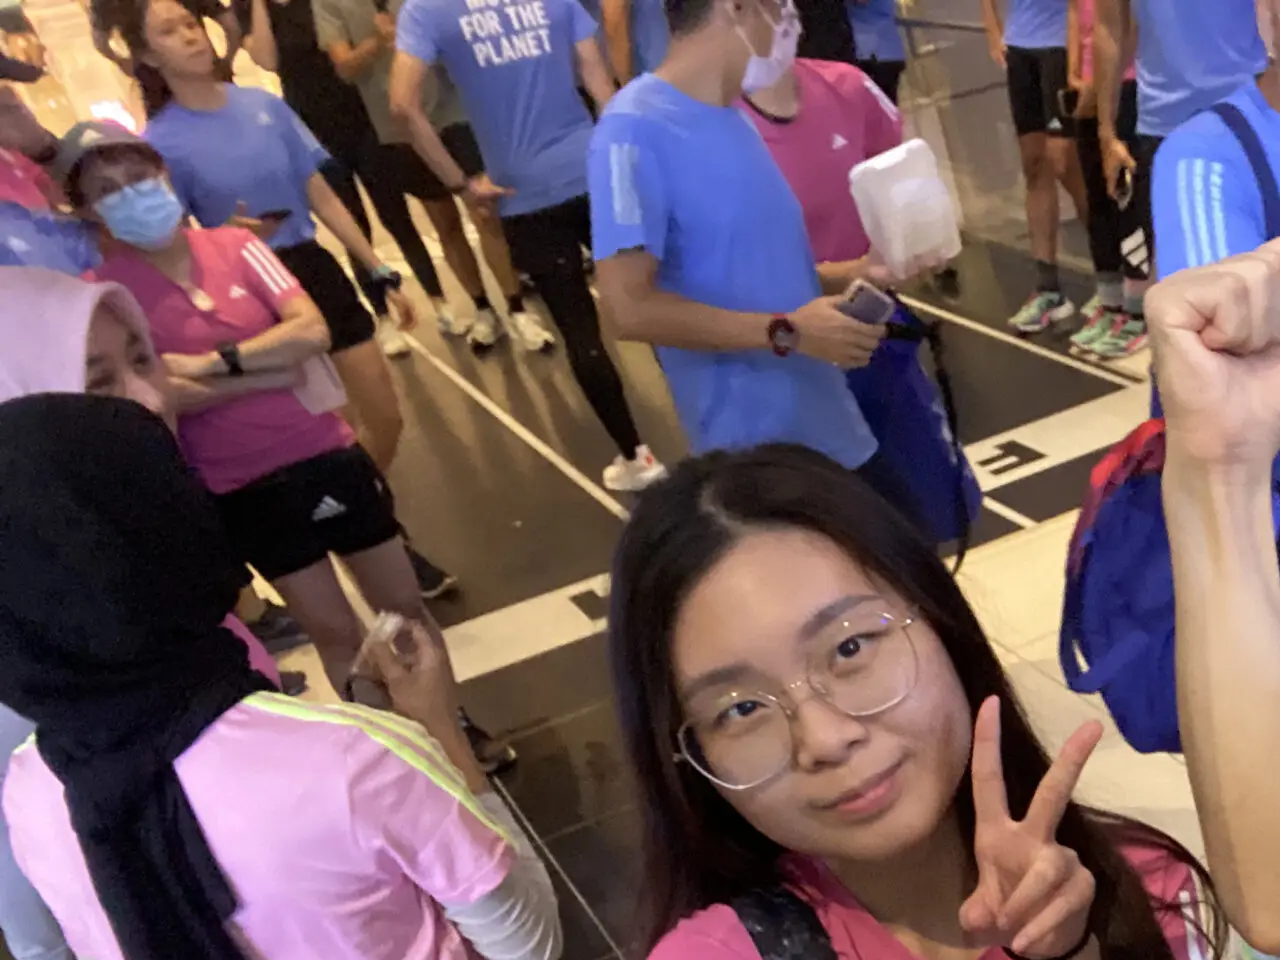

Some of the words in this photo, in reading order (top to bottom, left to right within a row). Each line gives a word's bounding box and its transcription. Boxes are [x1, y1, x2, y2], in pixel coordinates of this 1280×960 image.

[459, 10, 505, 43] FOR
[504, 1, 551, 31] THE
[472, 28, 552, 67] PLANET
